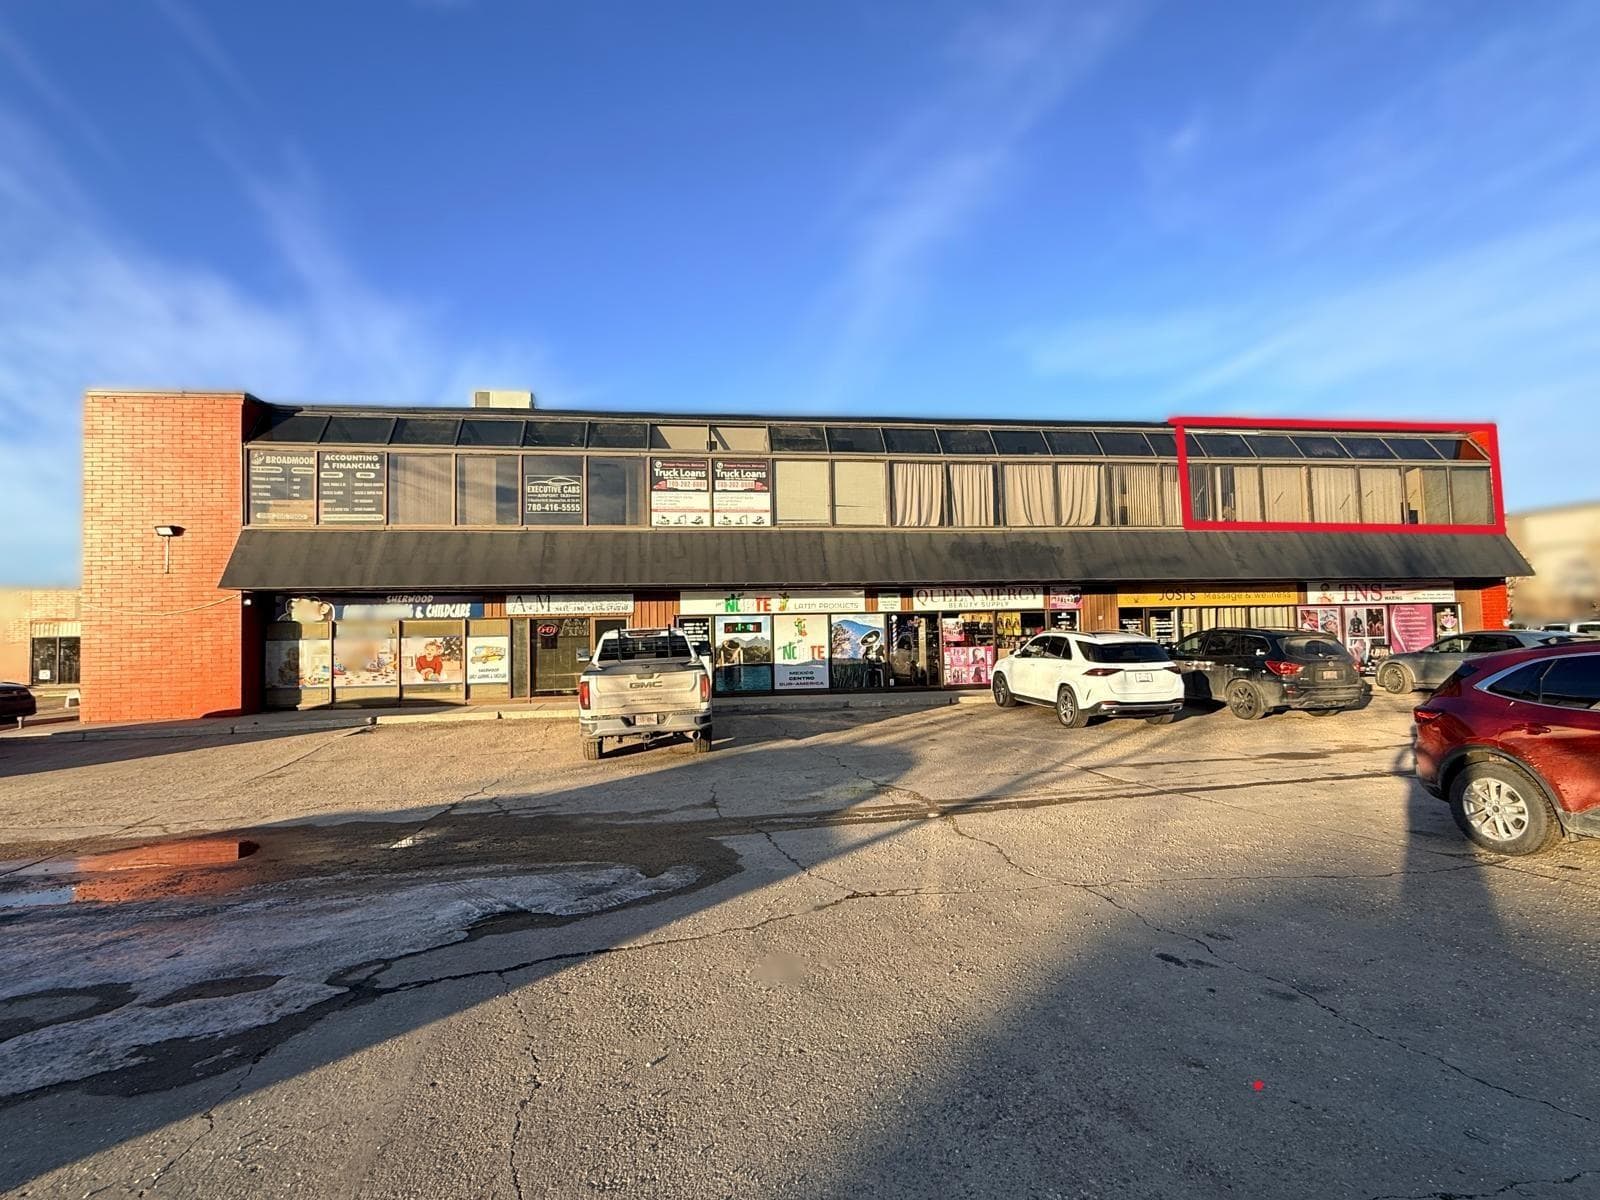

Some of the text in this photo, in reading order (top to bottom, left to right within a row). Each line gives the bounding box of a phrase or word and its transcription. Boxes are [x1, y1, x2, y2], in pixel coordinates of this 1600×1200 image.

[265, 455, 314, 465] BROADMOOR
[324, 454, 379, 462] ACCOUNTING
[332, 462, 380, 470] FINANCIALS
[653, 467, 706, 478] Truck Loans
[715, 468, 766, 478] Truck Loans
[527, 485, 562, 494] EXECUTIVE
[915, 588, 976, 606] QUEEN
[980, 587, 1039, 601] MERCY
[1338, 583, 1383, 602] TNS
[386, 595, 434, 603] SHERWOOD
[415, 606, 424, 618] &
[425, 603, 471, 618] CHILDCARE
[630, 681, 663, 689] GMC
